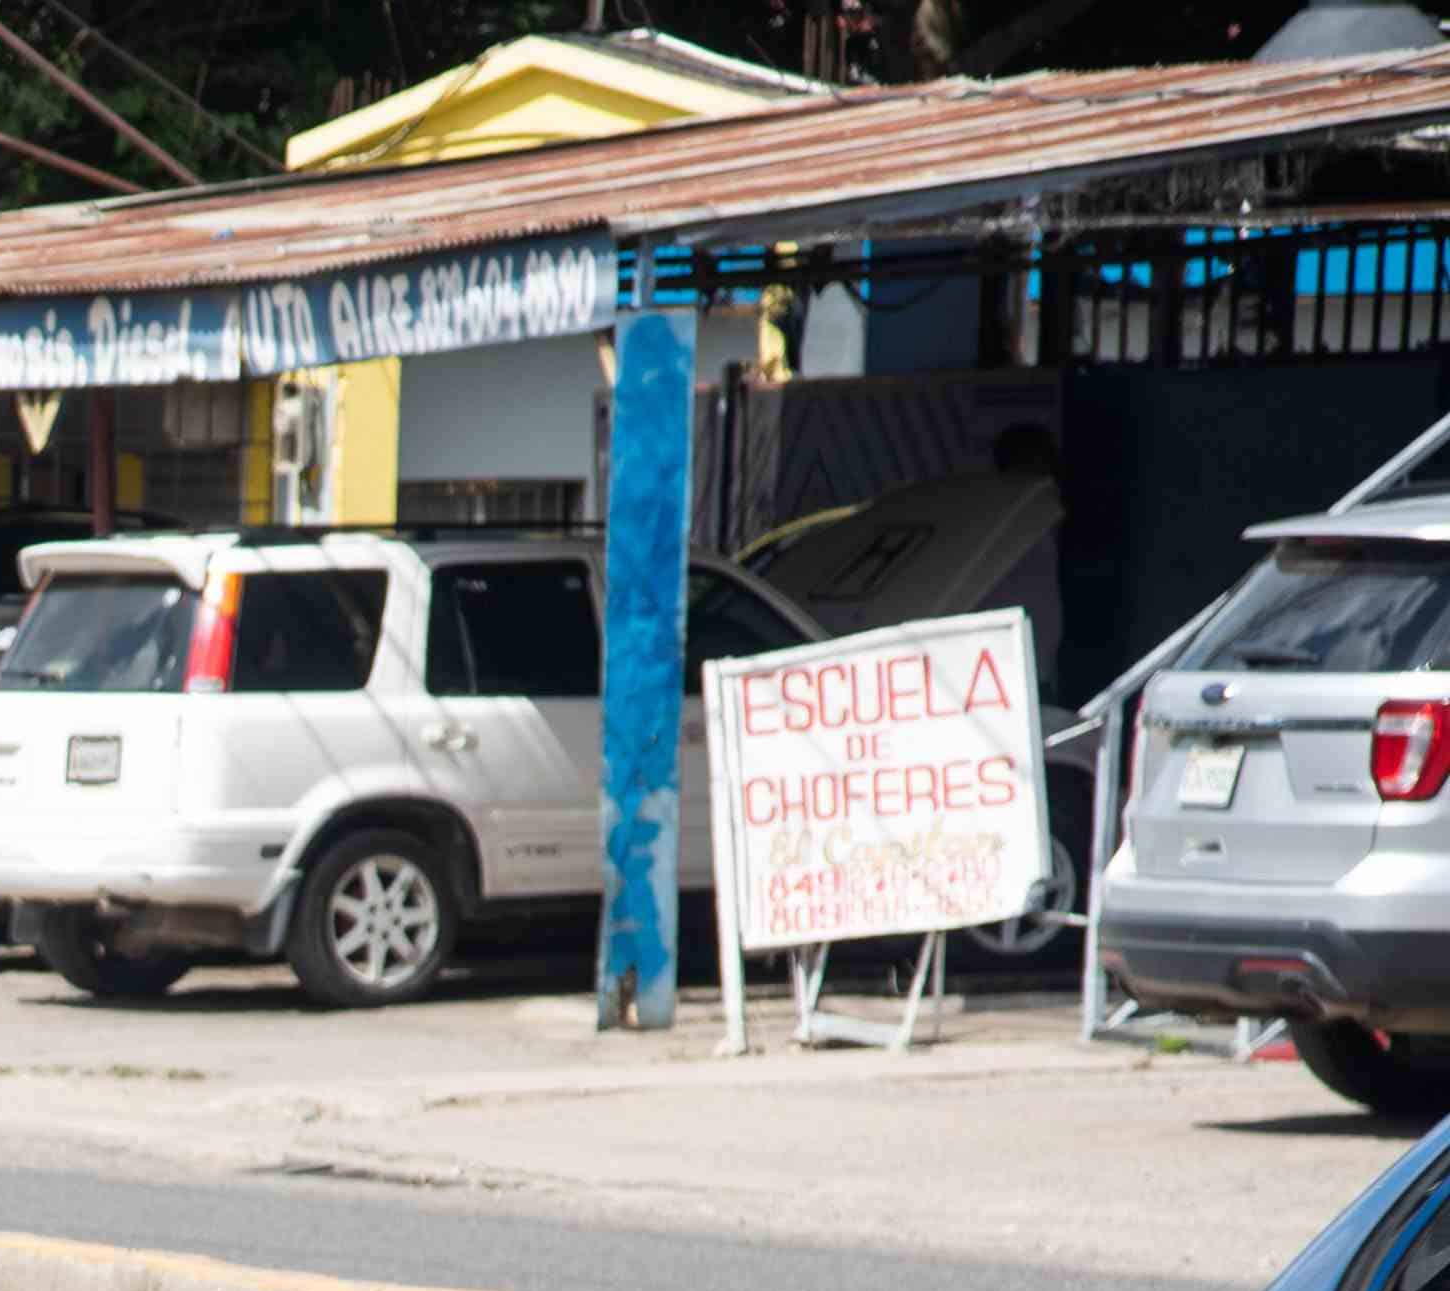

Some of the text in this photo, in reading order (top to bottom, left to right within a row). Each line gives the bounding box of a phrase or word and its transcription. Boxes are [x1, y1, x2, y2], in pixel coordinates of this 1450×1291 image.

[742, 648, 1011, 737] ESCUELA
[845, 731, 892, 763] DE
[742, 756, 1017, 828] CHOFERES
